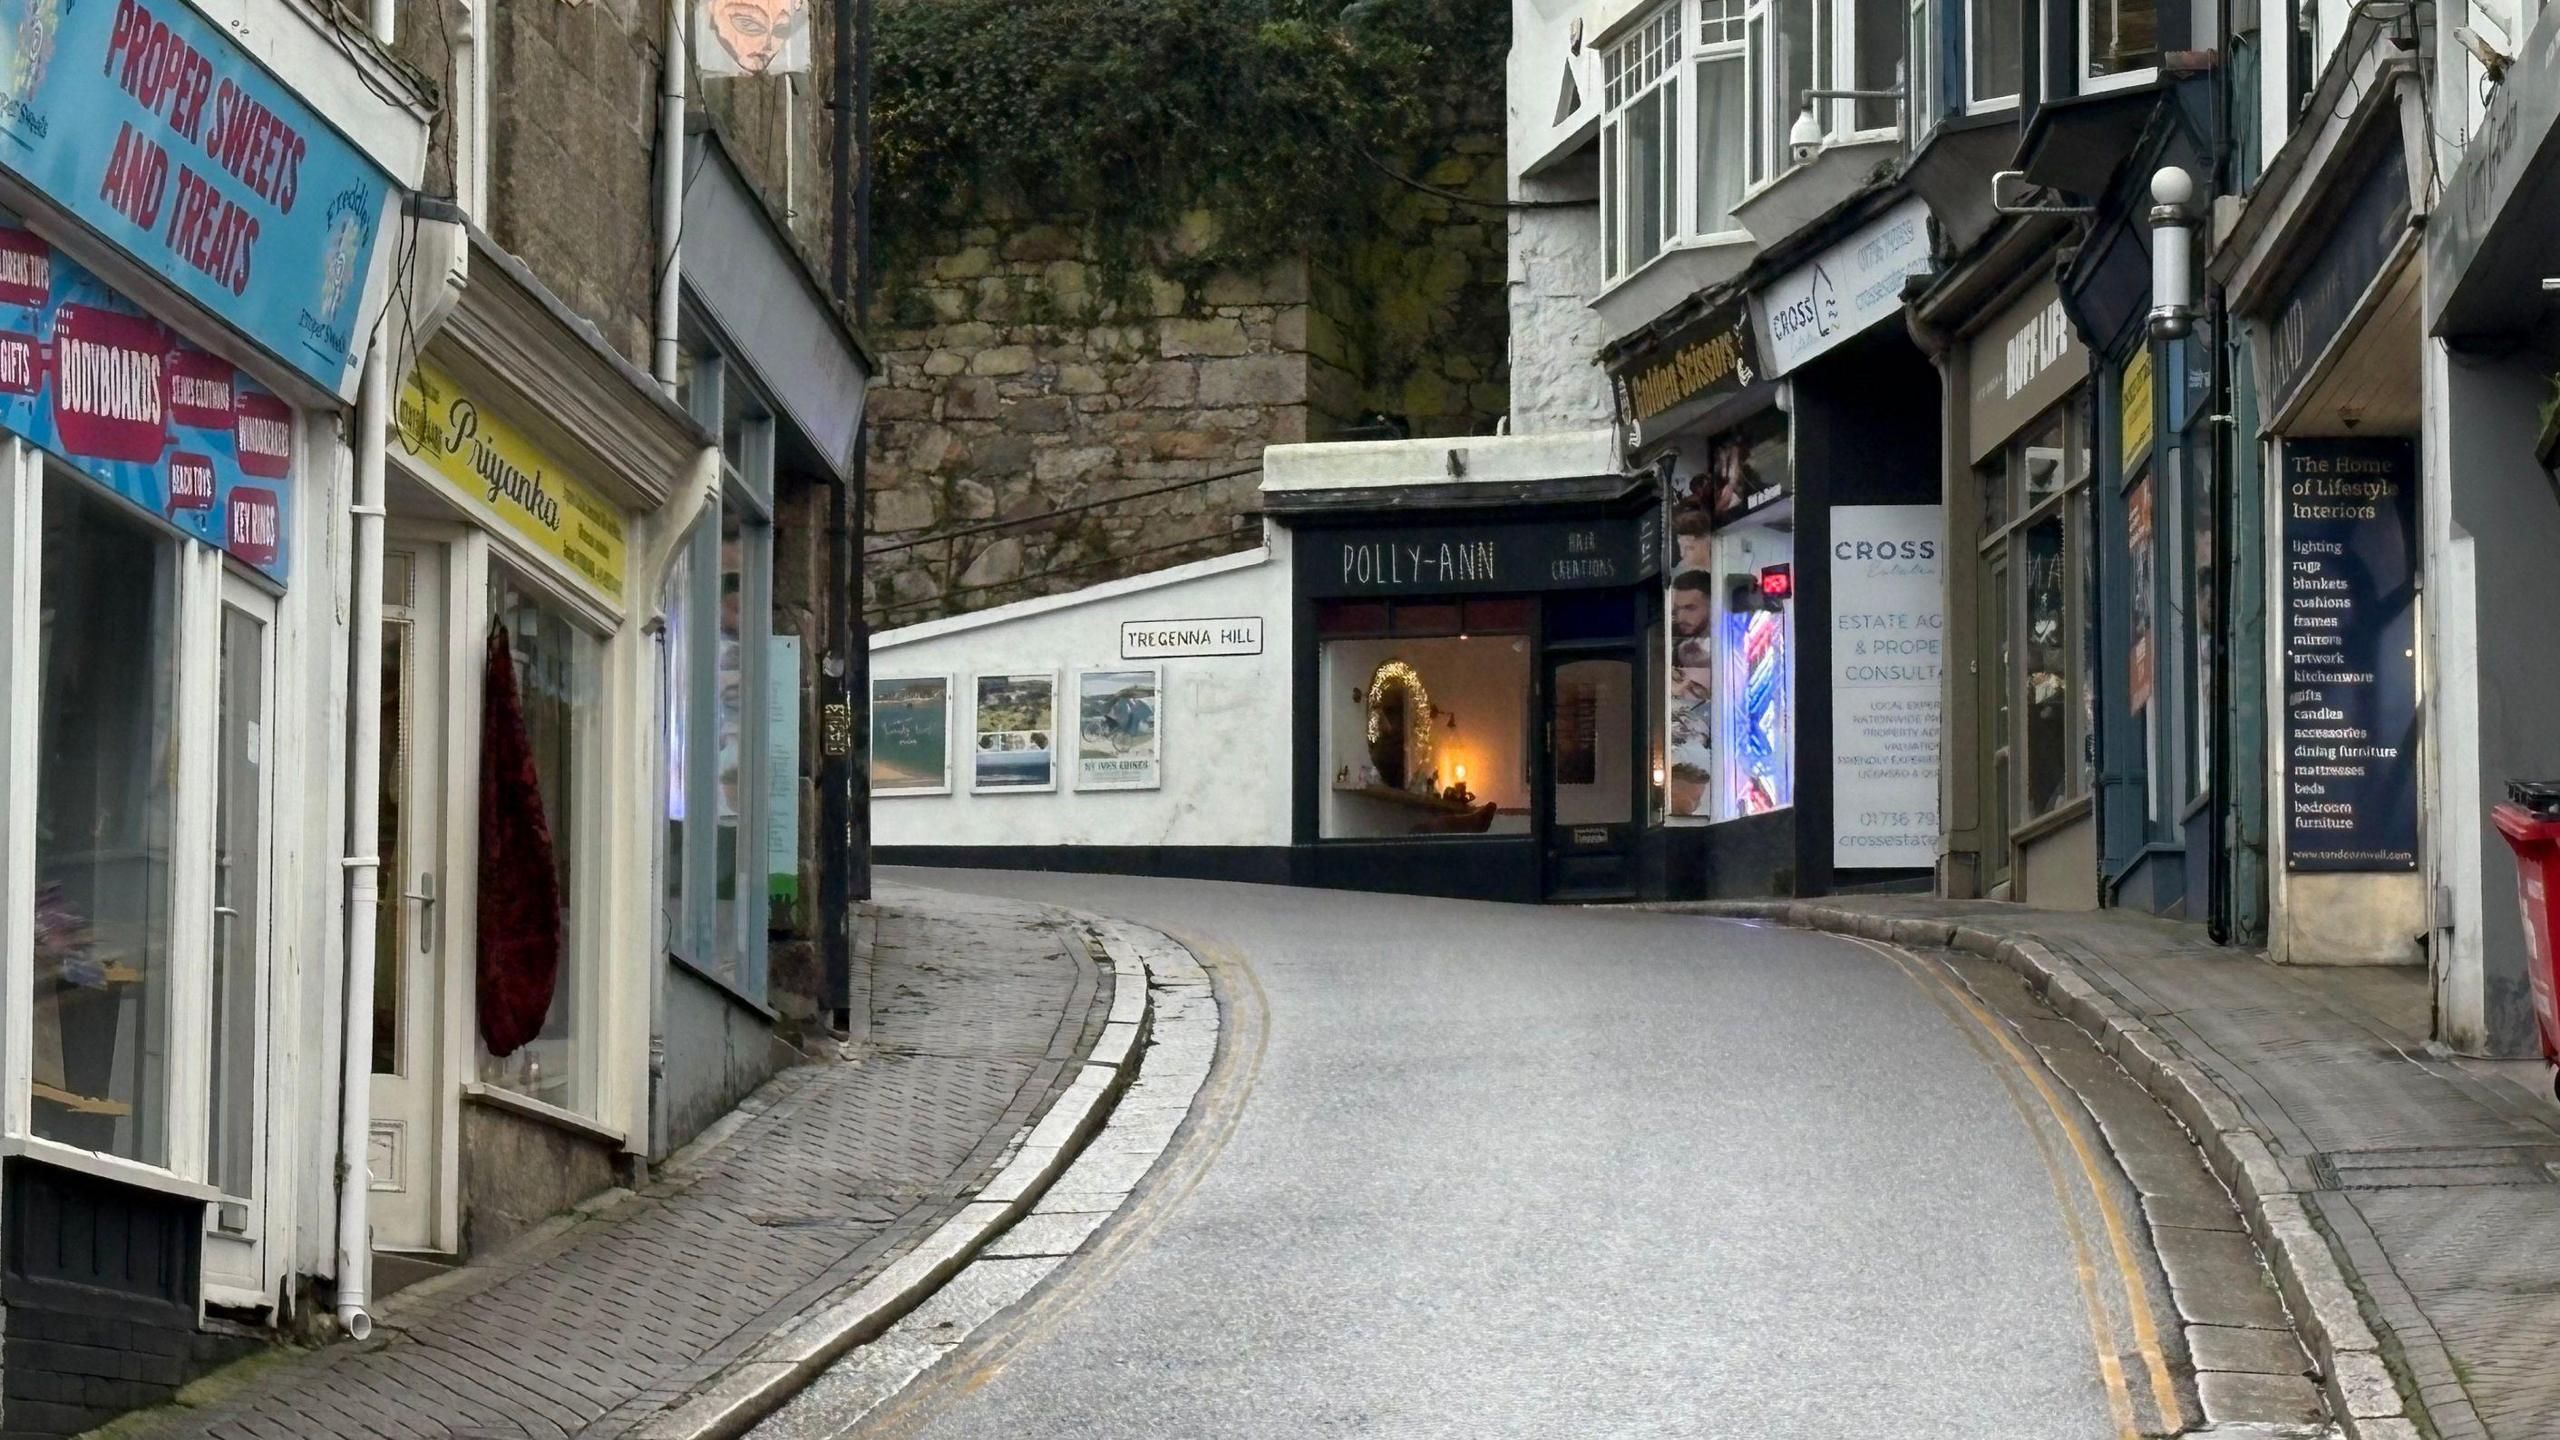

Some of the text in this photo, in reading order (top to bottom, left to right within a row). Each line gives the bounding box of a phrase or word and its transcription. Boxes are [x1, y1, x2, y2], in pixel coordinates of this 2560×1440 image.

[103, 0, 306, 216] PROPER SWEETS
[100, 120, 260, 297] AND TREATS
[30, 254, 49, 291] TOYS
[1773, 297, 1814, 341] CROSS
[0, 339, 30, 386] GIFTS
[2006, 315, 2039, 401] RUFF
[60, 337, 162, 425] BODYBOARDS
[1631, 364, 1680, 419] Golden
[1676, 331, 1736, 398] Scissors
[445, 398, 560, 532] Priyanka
[2291, 456, 2392, 474] The Home
[194, 467, 212, 499] TOYS
[2292, 478, 2399, 501] of Lifestyle
[2292, 502, 2376, 519] Interiors
[233, 500, 276, 547] KEY RINGS
[1834, 540, 1936, 561] CROSS
[2292, 540, 2344, 555] lighting
[1344, 541, 1494, 584] POLLY-ANN
[1551, 559, 1615, 581] CREATIONS
[2292, 577, 2348, 590] blankets
[2293, 596, 2351, 609] cushions
[1838, 614, 1909, 631] ESTATE
[2293, 614, 2338, 628] frames
[1128, 628, 1256, 648] TREGENNA HILL
[2293, 634, 2342, 646] mirrors
[1855, 641, 1867, 656] &
[2293, 652, 2344, 664] artwork
[2294, 670, 2374, 683] kitchenware
[2294, 707, 2343, 720] candles
[2294, 727, 2367, 739] accessories
[2294, 745, 2398, 760] dining furniture
[2294, 765, 2365, 776] mattresses
[2294, 782, 2325, 794] beds
[2294, 800, 2352, 813] bedroom
[1860, 811, 1910, 827] 01736
[2295, 817, 2354, 829] furniture
